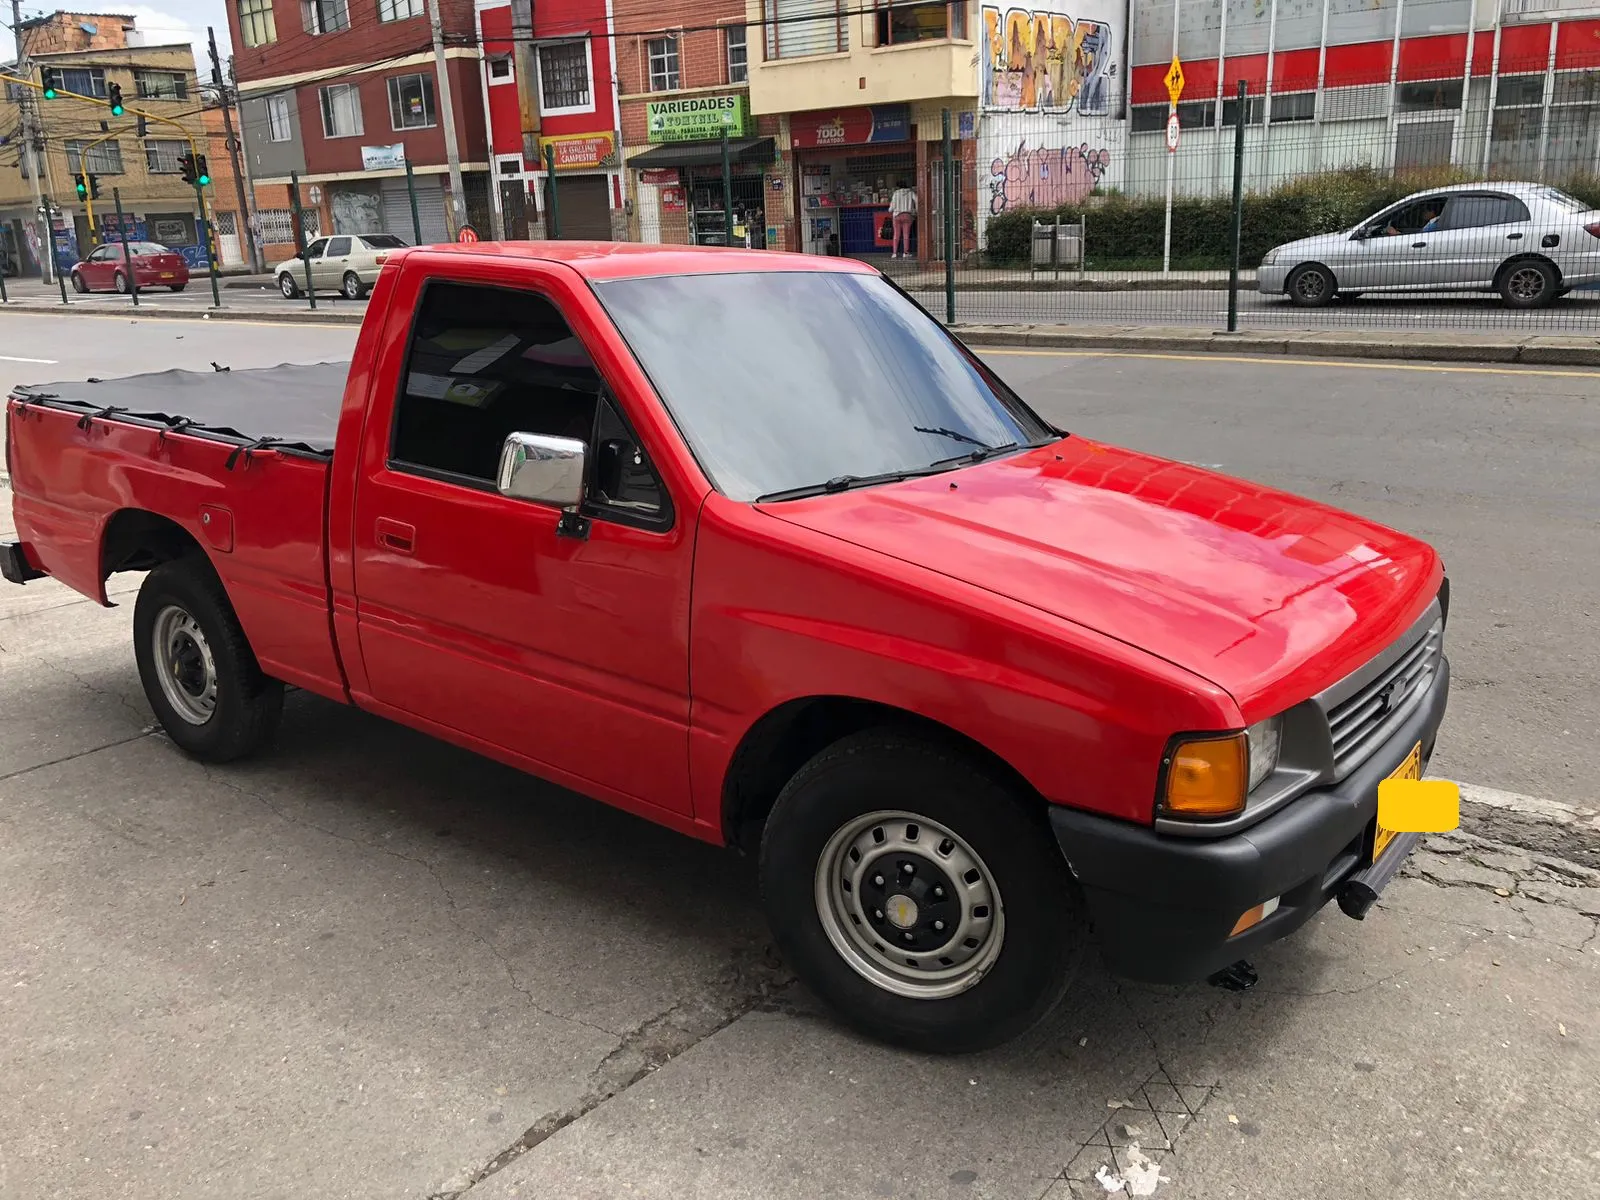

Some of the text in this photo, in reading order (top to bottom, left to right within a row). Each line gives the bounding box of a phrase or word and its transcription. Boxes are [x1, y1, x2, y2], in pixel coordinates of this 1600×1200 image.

[651, 97, 735, 114] VARIEDADES
[815, 128, 845, 139] TODO
[560, 152, 598, 164] CAMPESTRE
